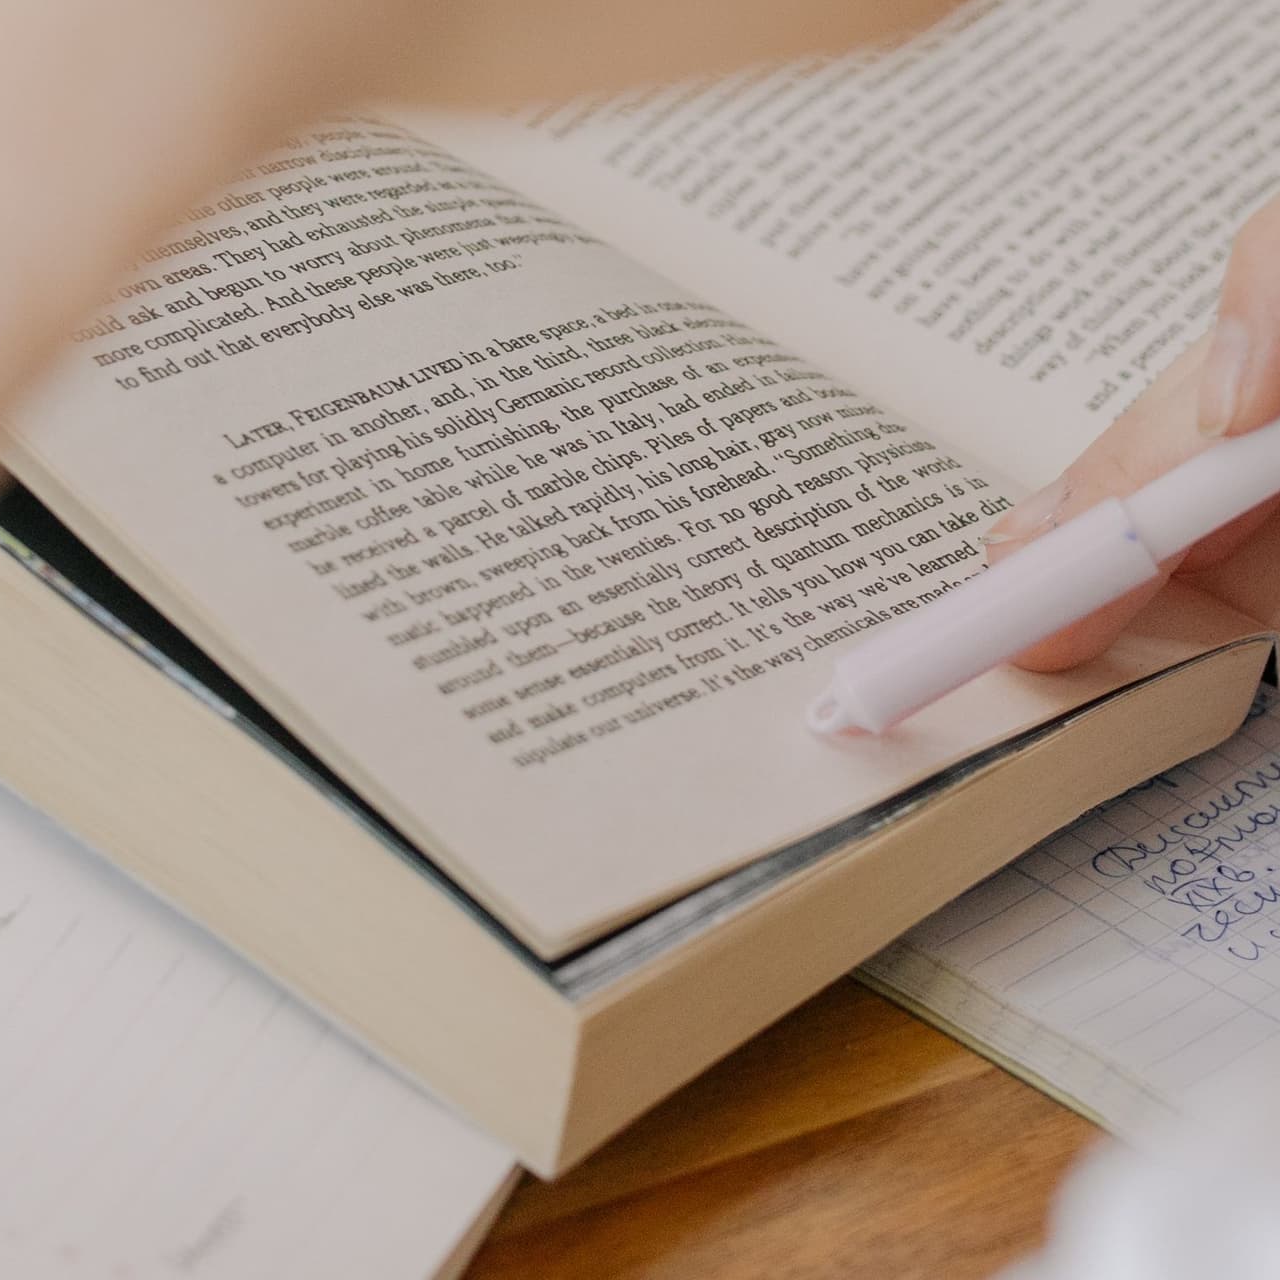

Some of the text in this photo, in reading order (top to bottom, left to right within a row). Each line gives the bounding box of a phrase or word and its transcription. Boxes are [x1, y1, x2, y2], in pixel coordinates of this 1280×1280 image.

[162, 207, 394, 284] areas. They had exhausted
[217, 169, 371, 211] other people were
[245, 193, 368, 231] and they were
[127, 234, 399, 325] ask and begun to worry about
[137, 254, 521, 383] find out that everybody else was there, too.”
[144, 247, 462, 349] complicated. And these people were
[222, 319, 596, 448] LATER, FEIGENBAUM LIVED in a bare space,
[329, 339, 723, 479] playing his solidly Germanic record collection.
[349, 333, 634, 437] another, and, in the third, three
[394, 361, 730, 482] home furnishing, the purchase of an
[463, 376, 755, 488] while he was in Italy, had ended
[1085, 379, 1119, 411] and
[438, 388, 813, 535] parcel of marble chips. Piles of papers and
[474, 411, 834, 549] He talked rapidly, his long hair, gray now
[478, 427, 880, 581] sweeping back from his forehead. “Something
[560, 465, 854, 581] the twenties. For no good reason
[587, 456, 962, 604] essentially correct description of the world
[646, 477, 989, 615] the theory of quantum mechanics is in
[665, 495, 1014, 642] correct. It tells you how you can take dirt
[699, 673, 736, 692] It’s
[731, 663, 766, 680] the
[763, 645, 804, 667] way
[803, 609, 892, 651] chemicals
[889, 599, 920, 615] are
[745, 540, 979, 642] It’s the way we’ve learned
